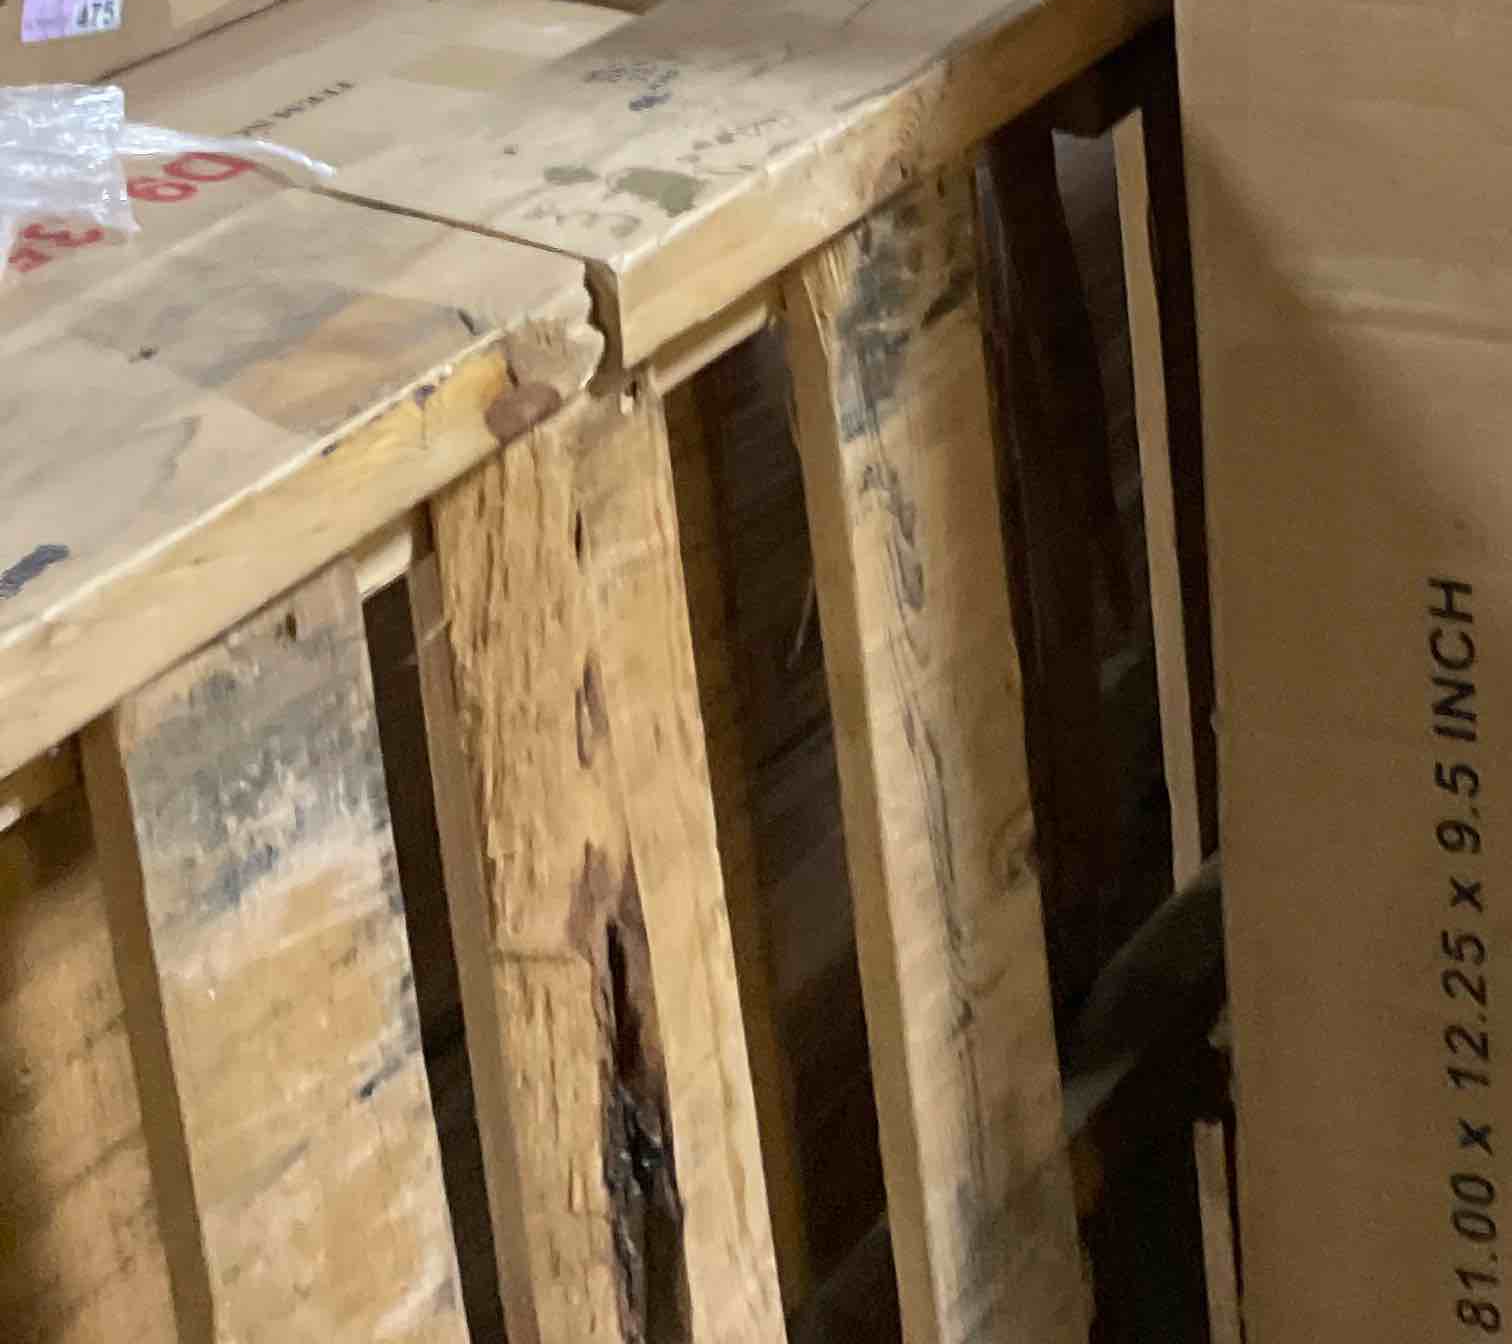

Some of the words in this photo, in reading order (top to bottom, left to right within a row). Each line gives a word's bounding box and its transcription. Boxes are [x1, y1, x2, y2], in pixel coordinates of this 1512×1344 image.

[1426, 576, 1480, 744] INCH
[1432, 762, 1486, 856] 9.5
[1450, 879, 1483, 913] x
[1440, 929, 1493, 1091] 12.25
[1456, 1119, 1494, 1156] x
[1446, 1173, 1502, 1336] 81.00
